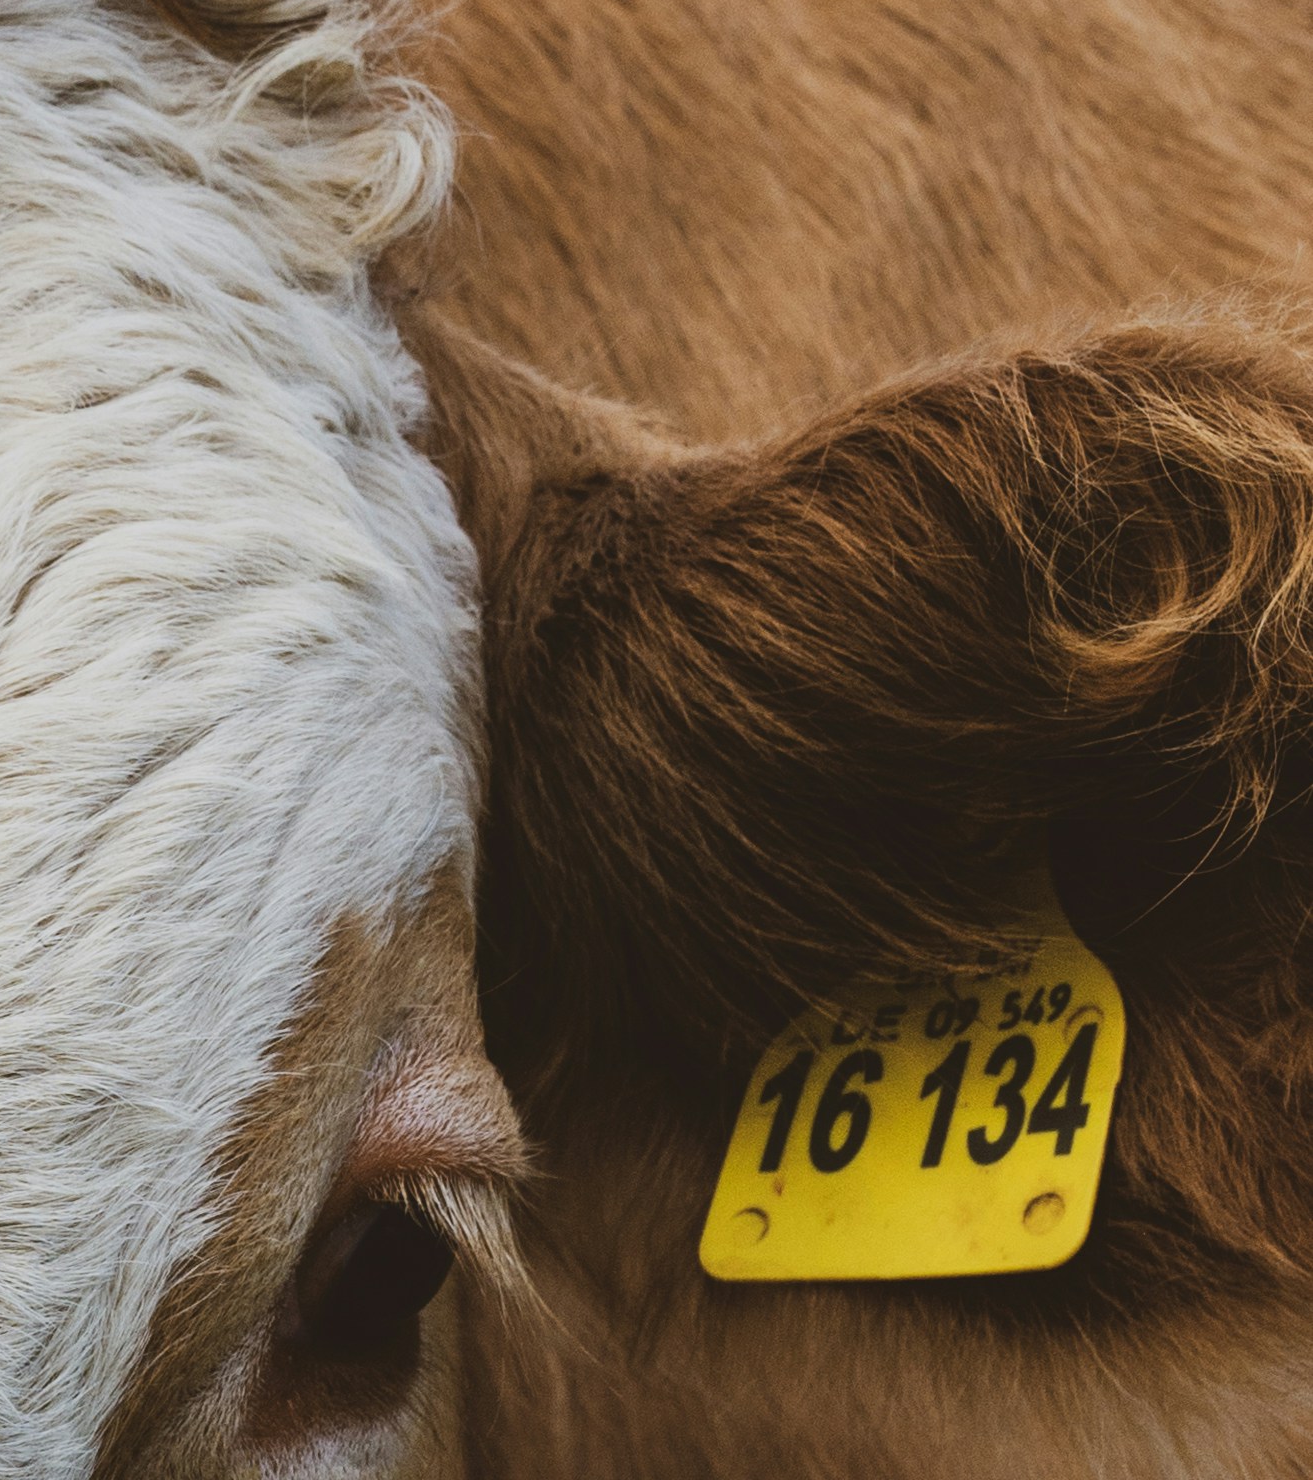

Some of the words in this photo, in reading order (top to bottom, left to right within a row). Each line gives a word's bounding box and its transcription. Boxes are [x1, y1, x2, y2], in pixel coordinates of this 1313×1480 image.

[923, 996, 981, 1040] 09
[997, 982, 1073, 1031] 549
[757, 1048, 885, 1175] 16
[918, 1021, 1100, 1170] 134
